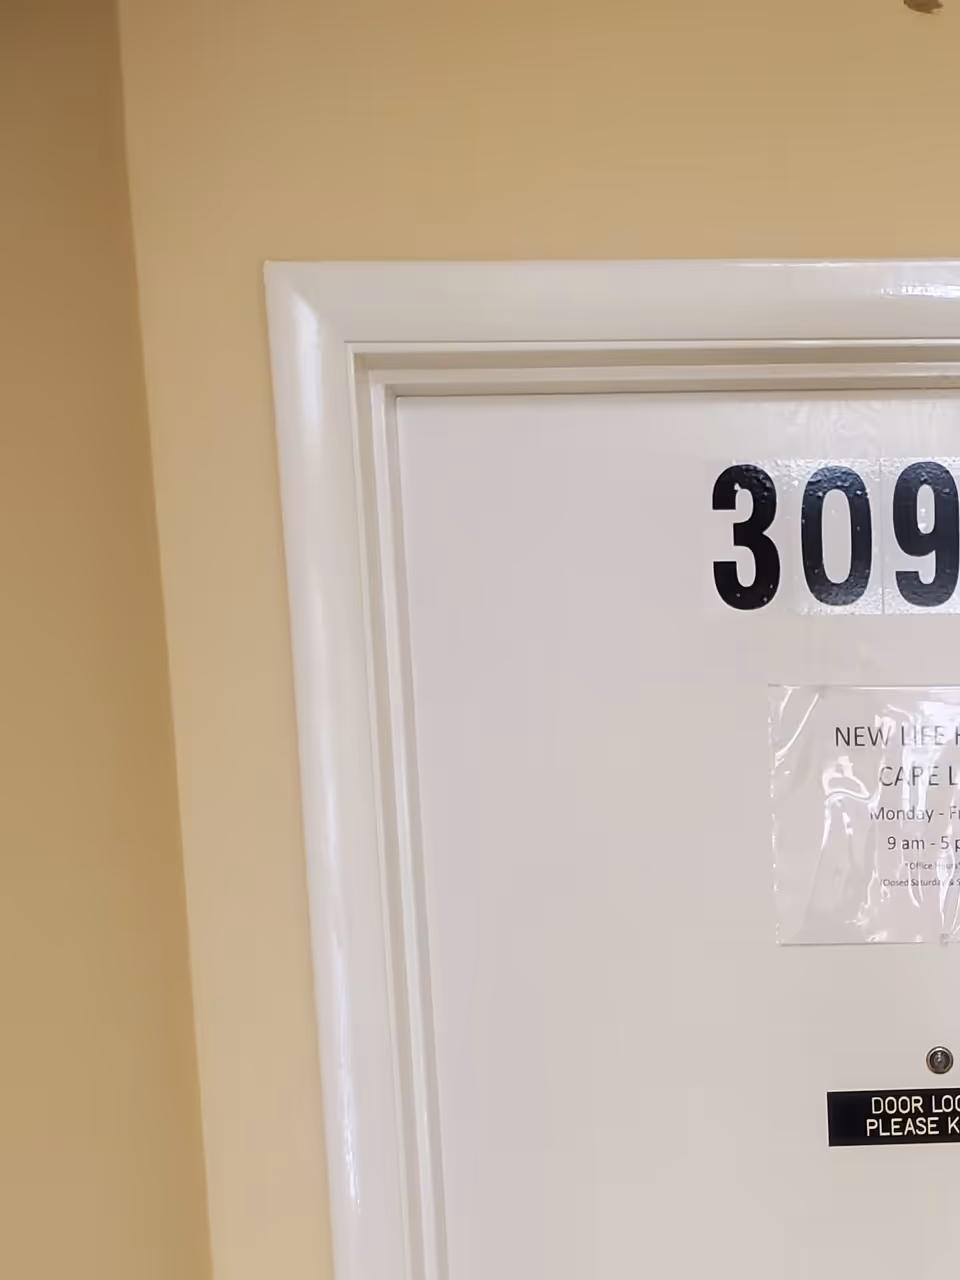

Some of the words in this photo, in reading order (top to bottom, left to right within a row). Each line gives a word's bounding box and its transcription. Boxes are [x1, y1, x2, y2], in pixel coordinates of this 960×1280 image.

[712, 461, 960, 610] 309
[835, 726, 890, 747] NEW
[901, 724, 945, 746] LIFE
[870, 805, 934, 823] Monday
[887, 836, 896, 850] 9
[901, 839, 925, 850] am
[940, 835, 949, 850] 5
[871, 1095, 924, 1115] DOOR
[866, 1116, 940, 1137] PLEASE
